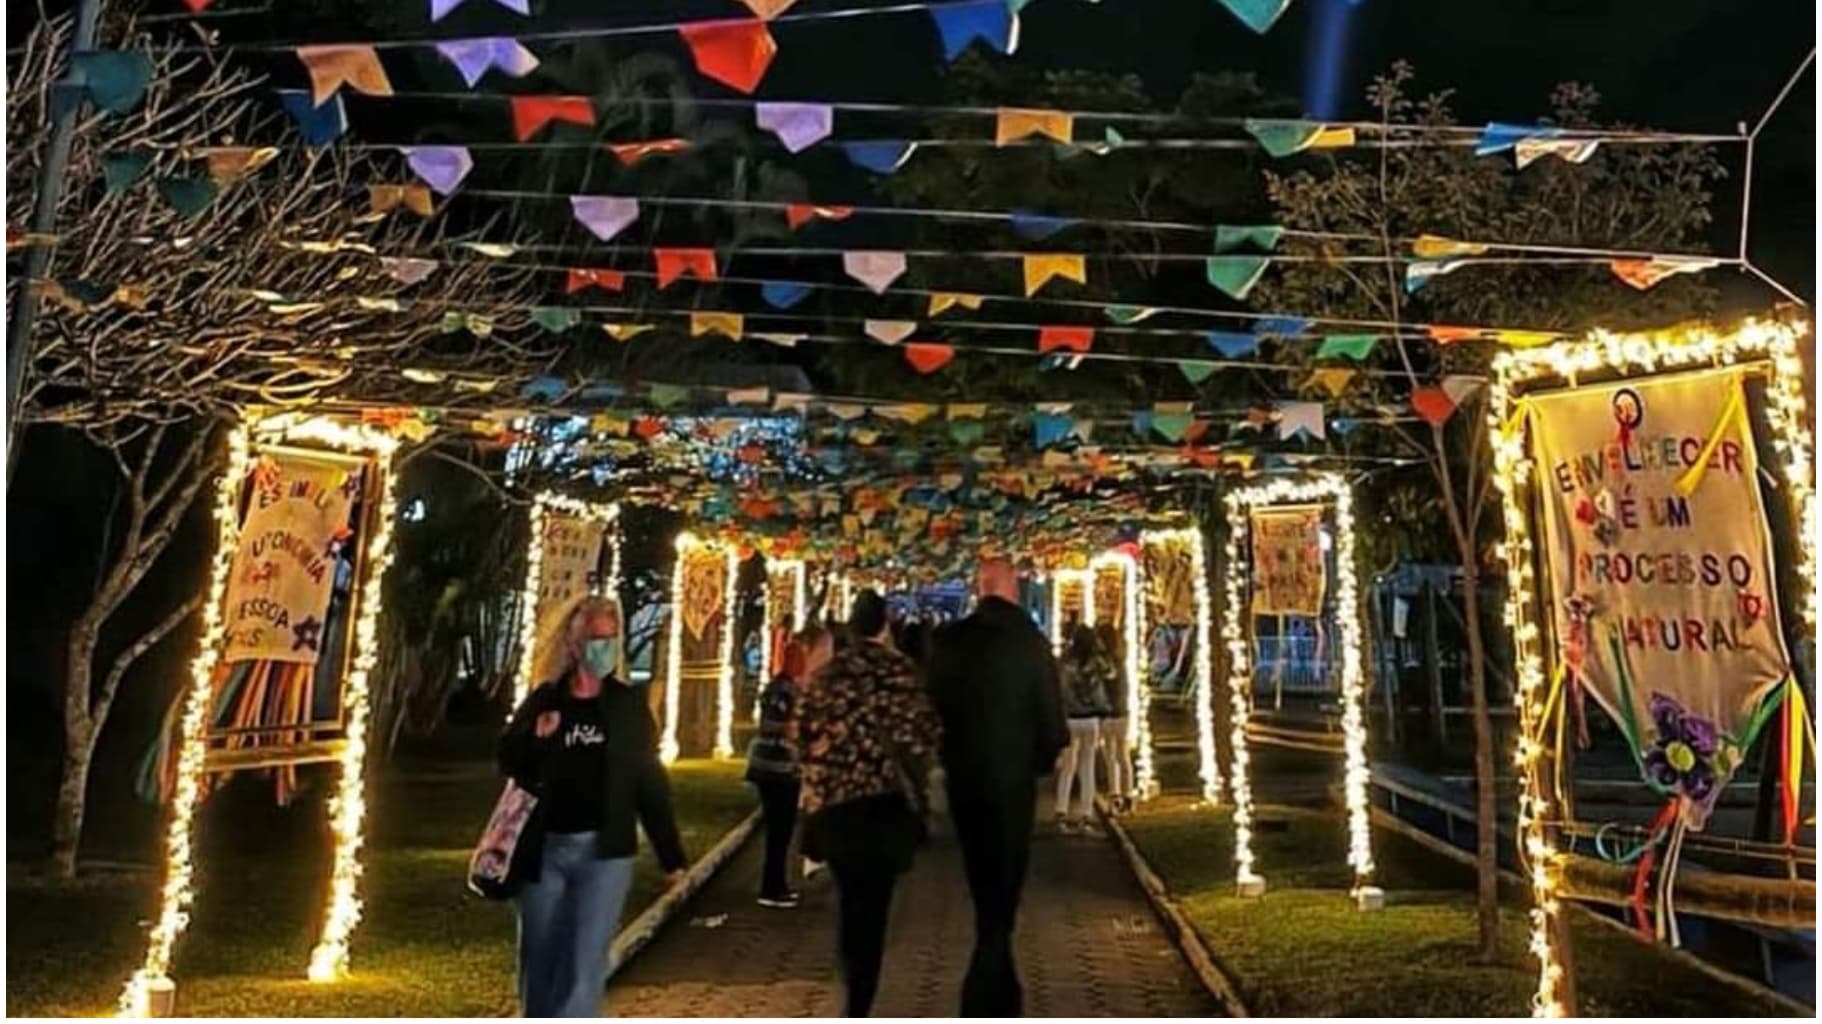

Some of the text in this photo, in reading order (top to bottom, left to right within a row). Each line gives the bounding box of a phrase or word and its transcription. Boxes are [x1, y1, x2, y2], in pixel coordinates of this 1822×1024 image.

[1620, 483, 1691, 528] É UM
[1579, 552, 1751, 587] PROCESSO
